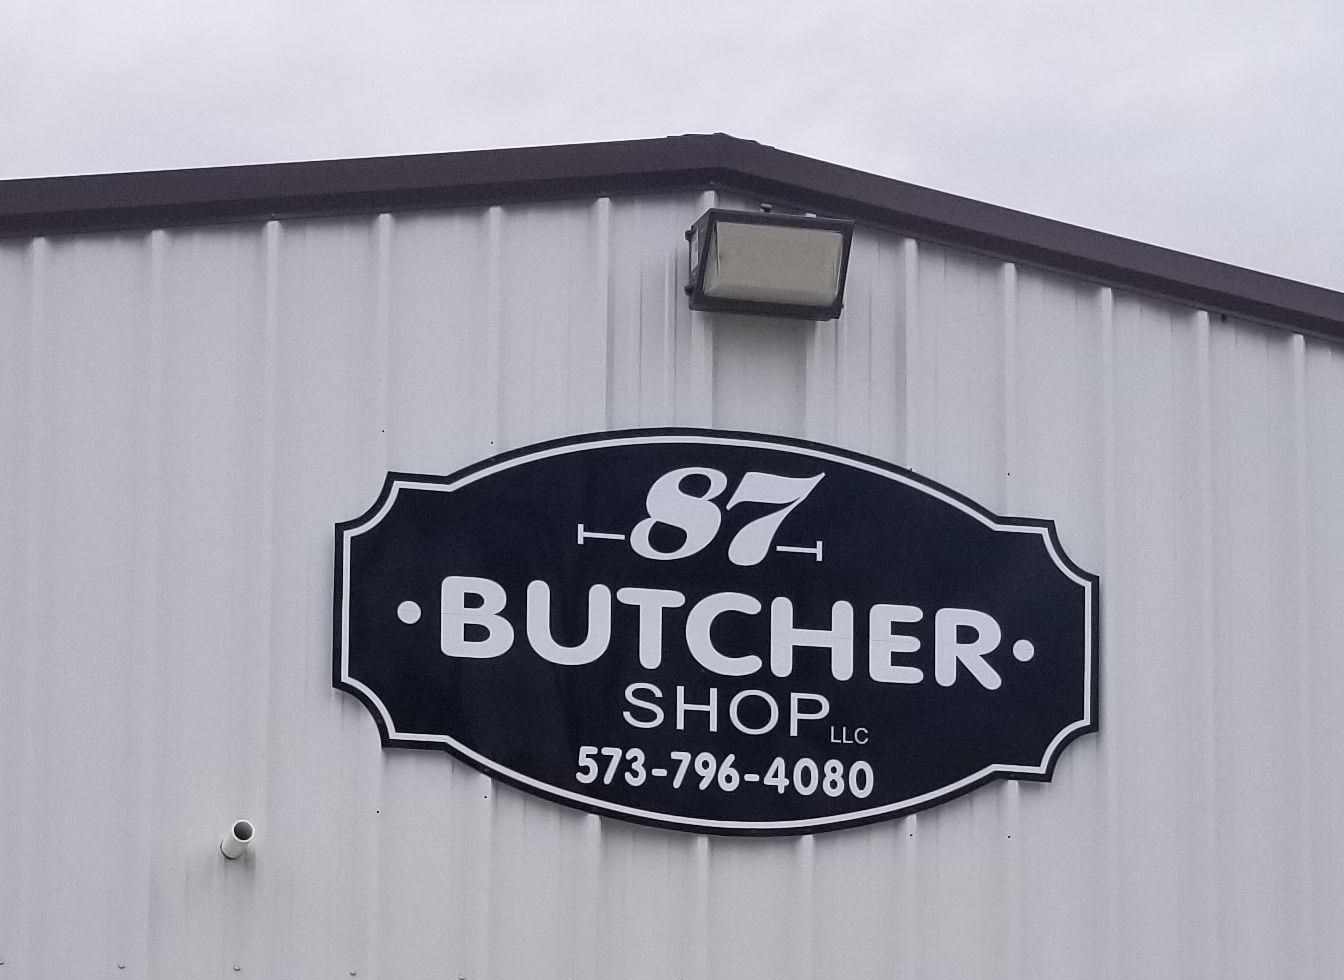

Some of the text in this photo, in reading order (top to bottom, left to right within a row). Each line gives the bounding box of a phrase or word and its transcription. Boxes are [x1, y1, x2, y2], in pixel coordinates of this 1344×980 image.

[629, 466, 826, 567] 87
[440, 575, 1003, 691] BUTCHER
[622, 682, 869, 745] SHOP LLC
[575, 745, 874, 799] 573-796-4080
